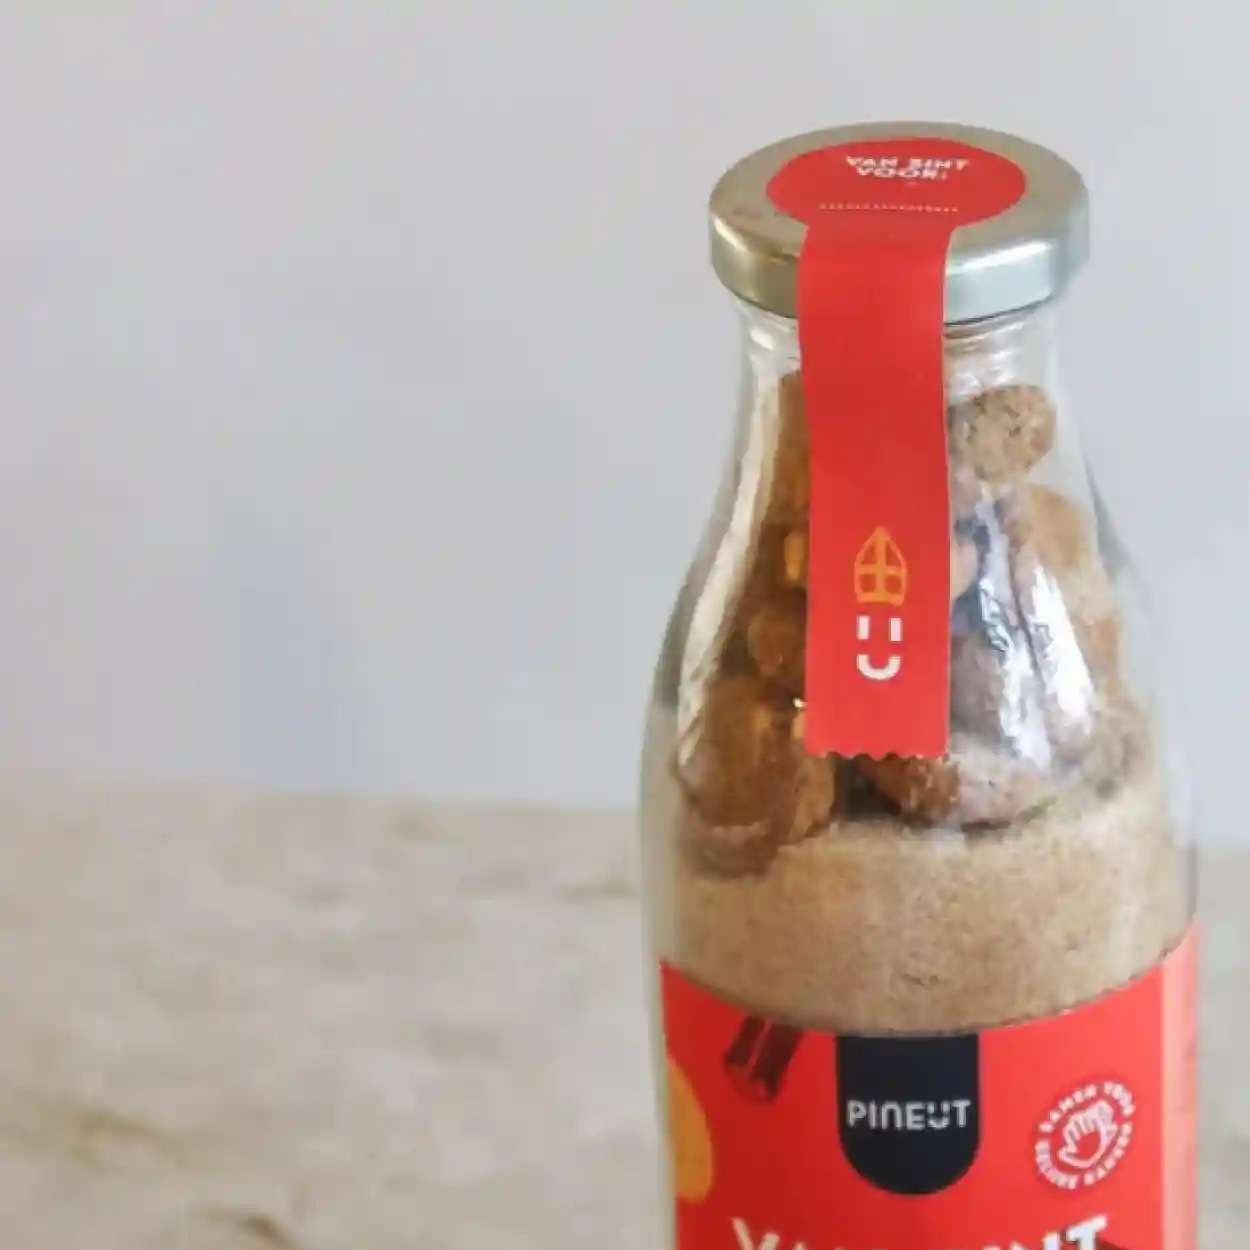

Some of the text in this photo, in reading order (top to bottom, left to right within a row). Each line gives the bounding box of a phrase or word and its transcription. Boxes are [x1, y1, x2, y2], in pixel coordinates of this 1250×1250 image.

[846, 156, 968, 170] VAN SINT
[847, 1099, 971, 1130] PINEUT
